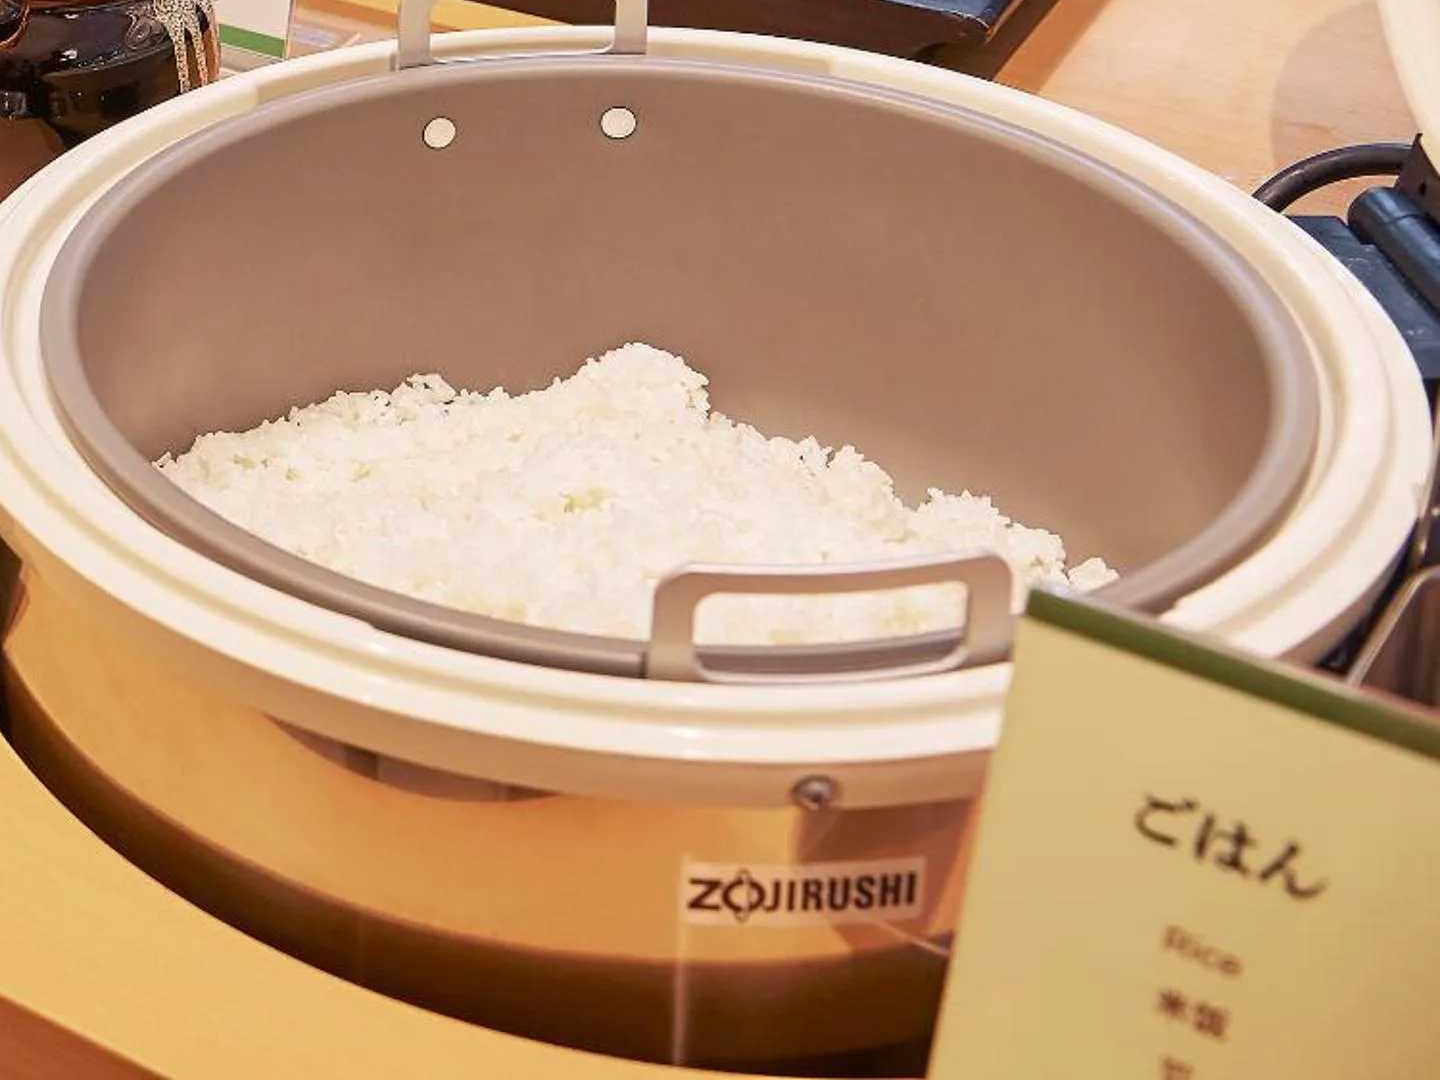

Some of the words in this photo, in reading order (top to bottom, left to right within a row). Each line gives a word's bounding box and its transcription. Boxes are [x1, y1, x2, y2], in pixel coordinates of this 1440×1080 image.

[1133, 792, 1330, 901] ごはん
[687, 869, 918, 922] ZOJIRUSHI
